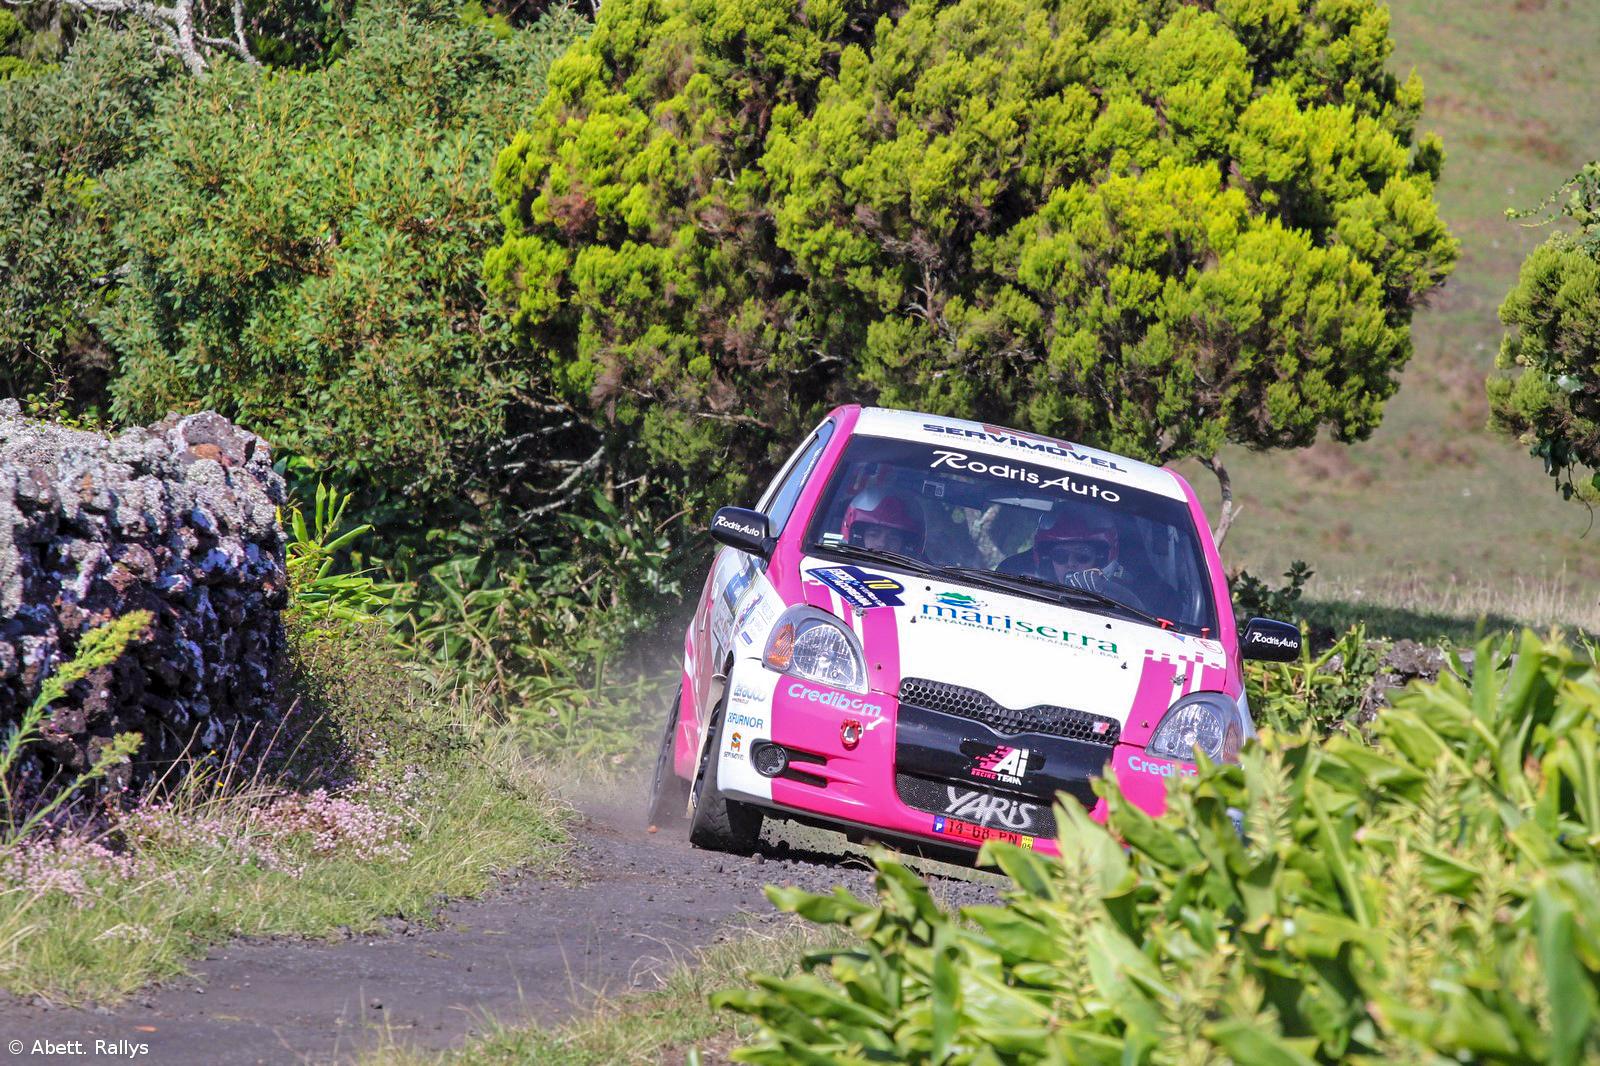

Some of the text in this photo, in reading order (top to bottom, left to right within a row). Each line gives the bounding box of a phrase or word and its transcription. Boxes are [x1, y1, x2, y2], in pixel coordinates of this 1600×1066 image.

[863, 578, 900, 590] 10
[919, 614, 1011, 634] RESTAURANTE
[922, 603, 1119, 654] mariserra
[787, 683, 882, 718] Credibom
[997, 773, 1022, 786] TEAM
